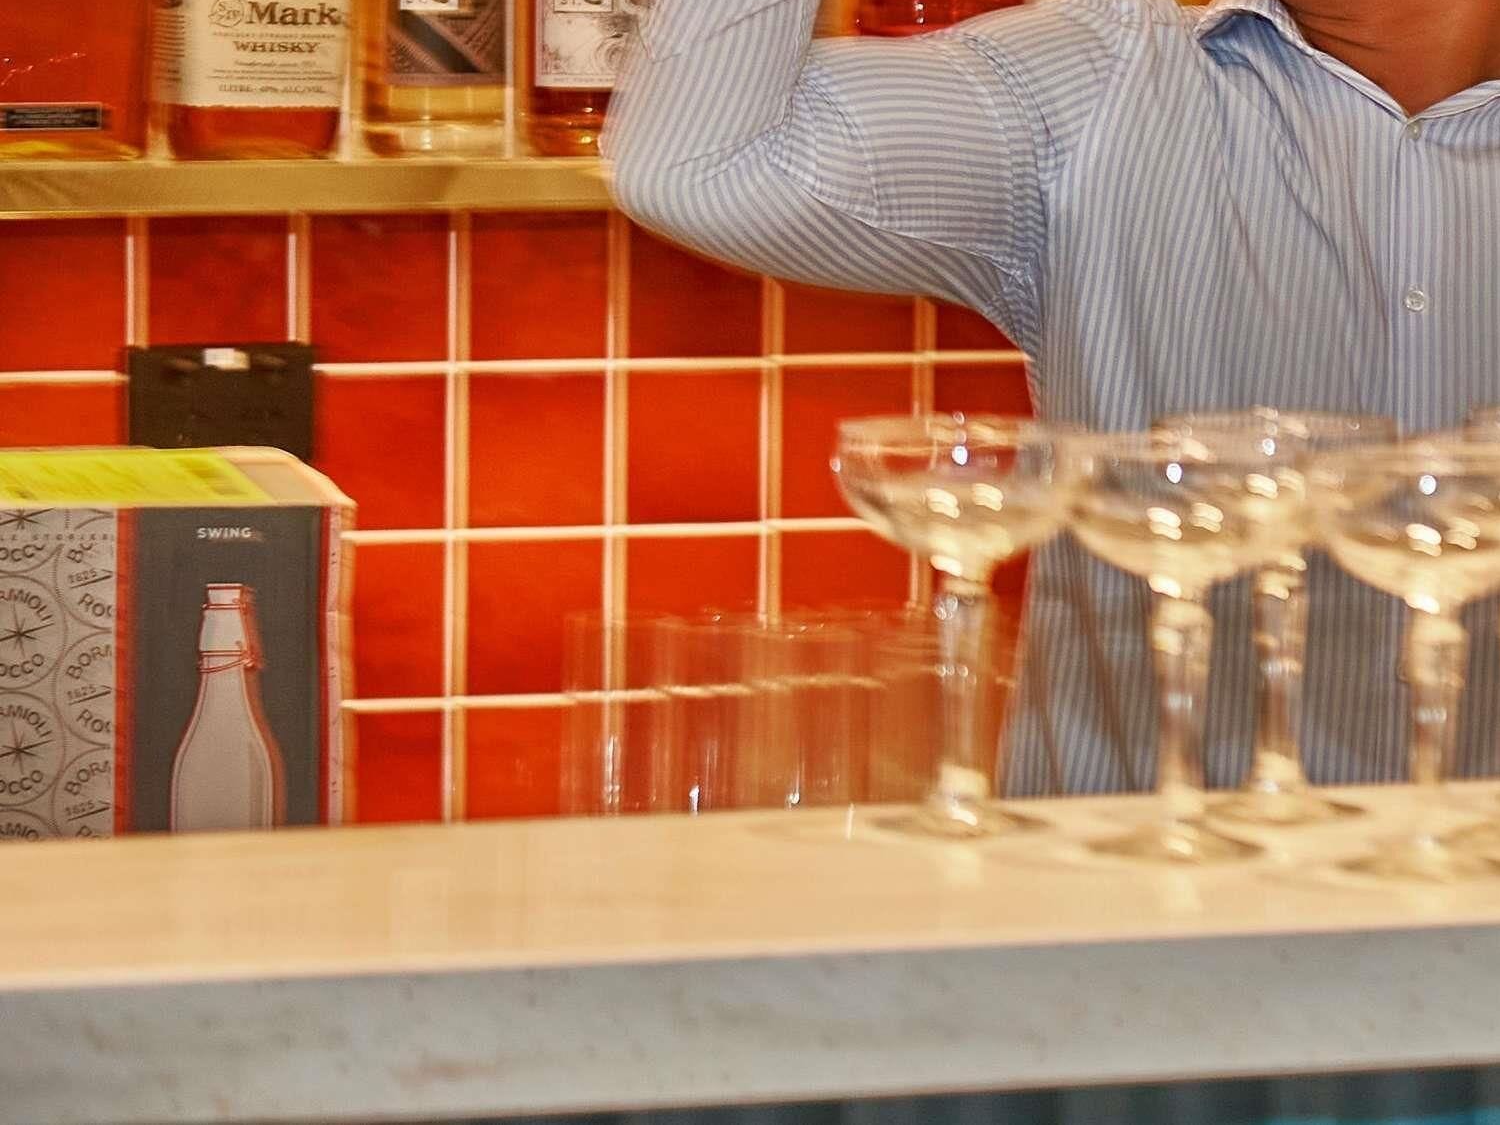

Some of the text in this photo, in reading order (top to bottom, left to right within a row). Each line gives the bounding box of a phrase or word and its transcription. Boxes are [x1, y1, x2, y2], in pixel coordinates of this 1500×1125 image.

[246, 1, 341, 26] Mark
[232, 40, 321, 54] WHISKY
[197, 526, 252, 539] SWING
[0, 703, 53, 739] MIOLI
